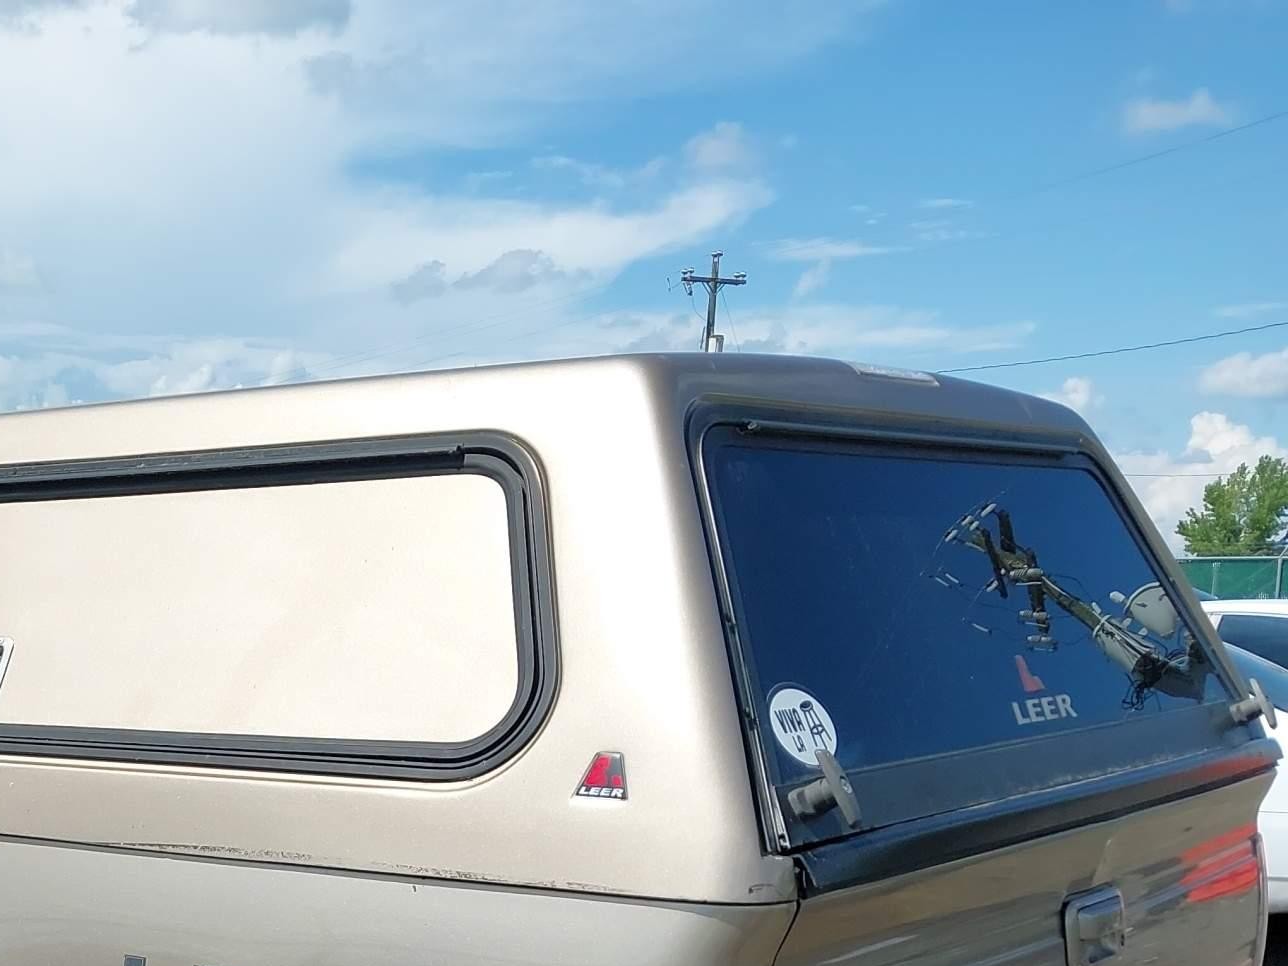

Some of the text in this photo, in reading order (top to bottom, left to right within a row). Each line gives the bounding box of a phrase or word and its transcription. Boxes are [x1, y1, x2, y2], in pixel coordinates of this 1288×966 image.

[1012, 694, 1078, 725] LEER
[774, 708, 806, 734] VIVA
[792, 735, 807, 752] LA
[578, 786, 624, 798] LEER
